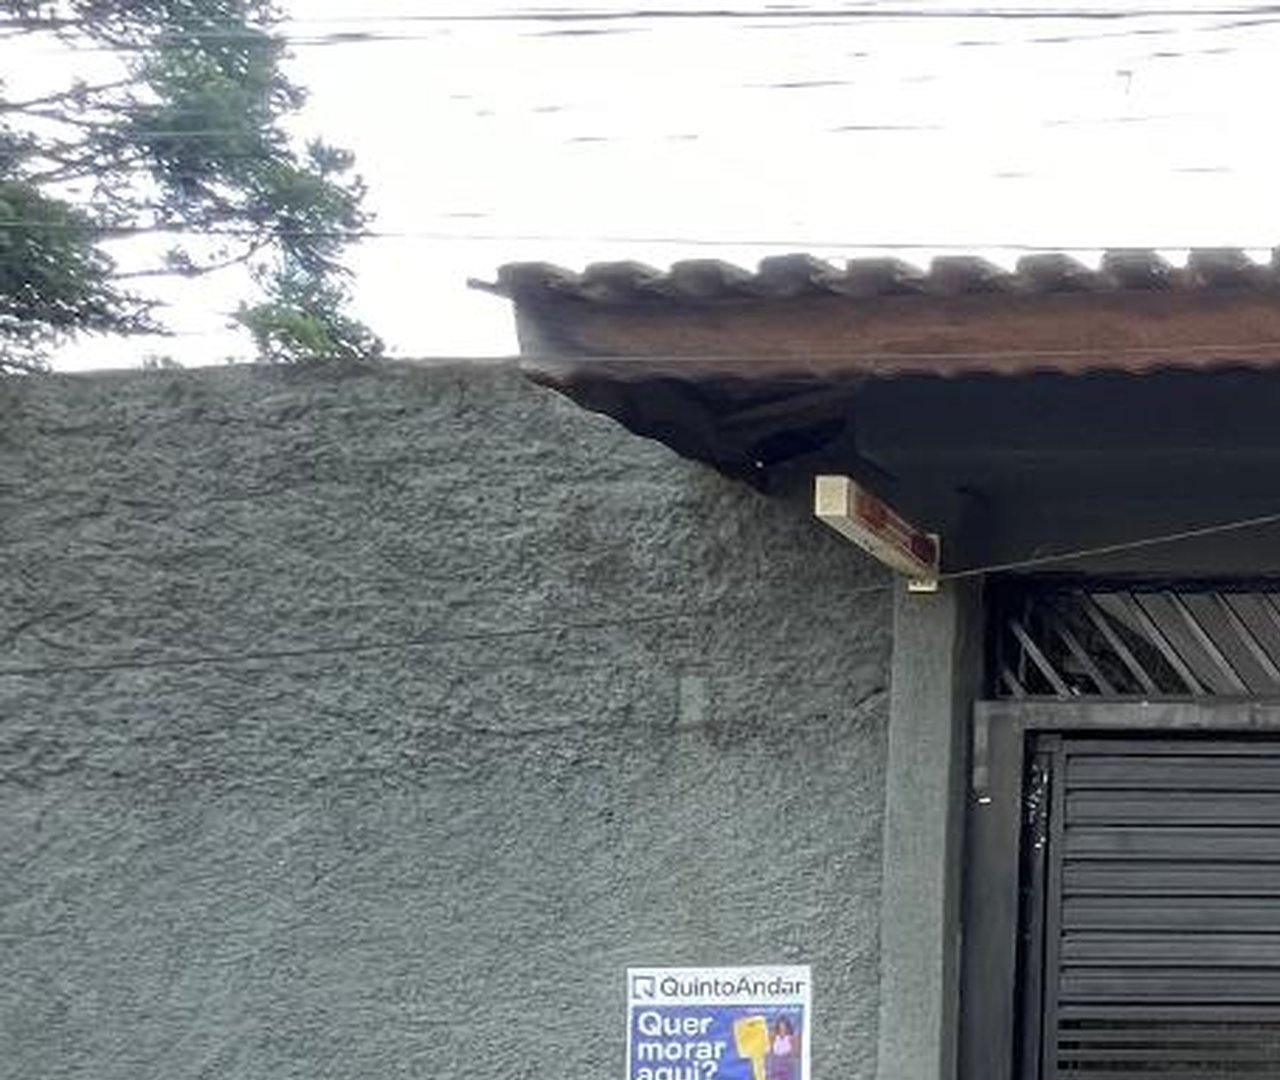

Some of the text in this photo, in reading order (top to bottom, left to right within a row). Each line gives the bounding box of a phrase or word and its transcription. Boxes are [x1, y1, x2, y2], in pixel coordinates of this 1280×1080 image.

[660, 976, 806, 998] QuintoAndar
[637, 1012, 713, 1036] Quer
[637, 1041, 727, 1060] morar
